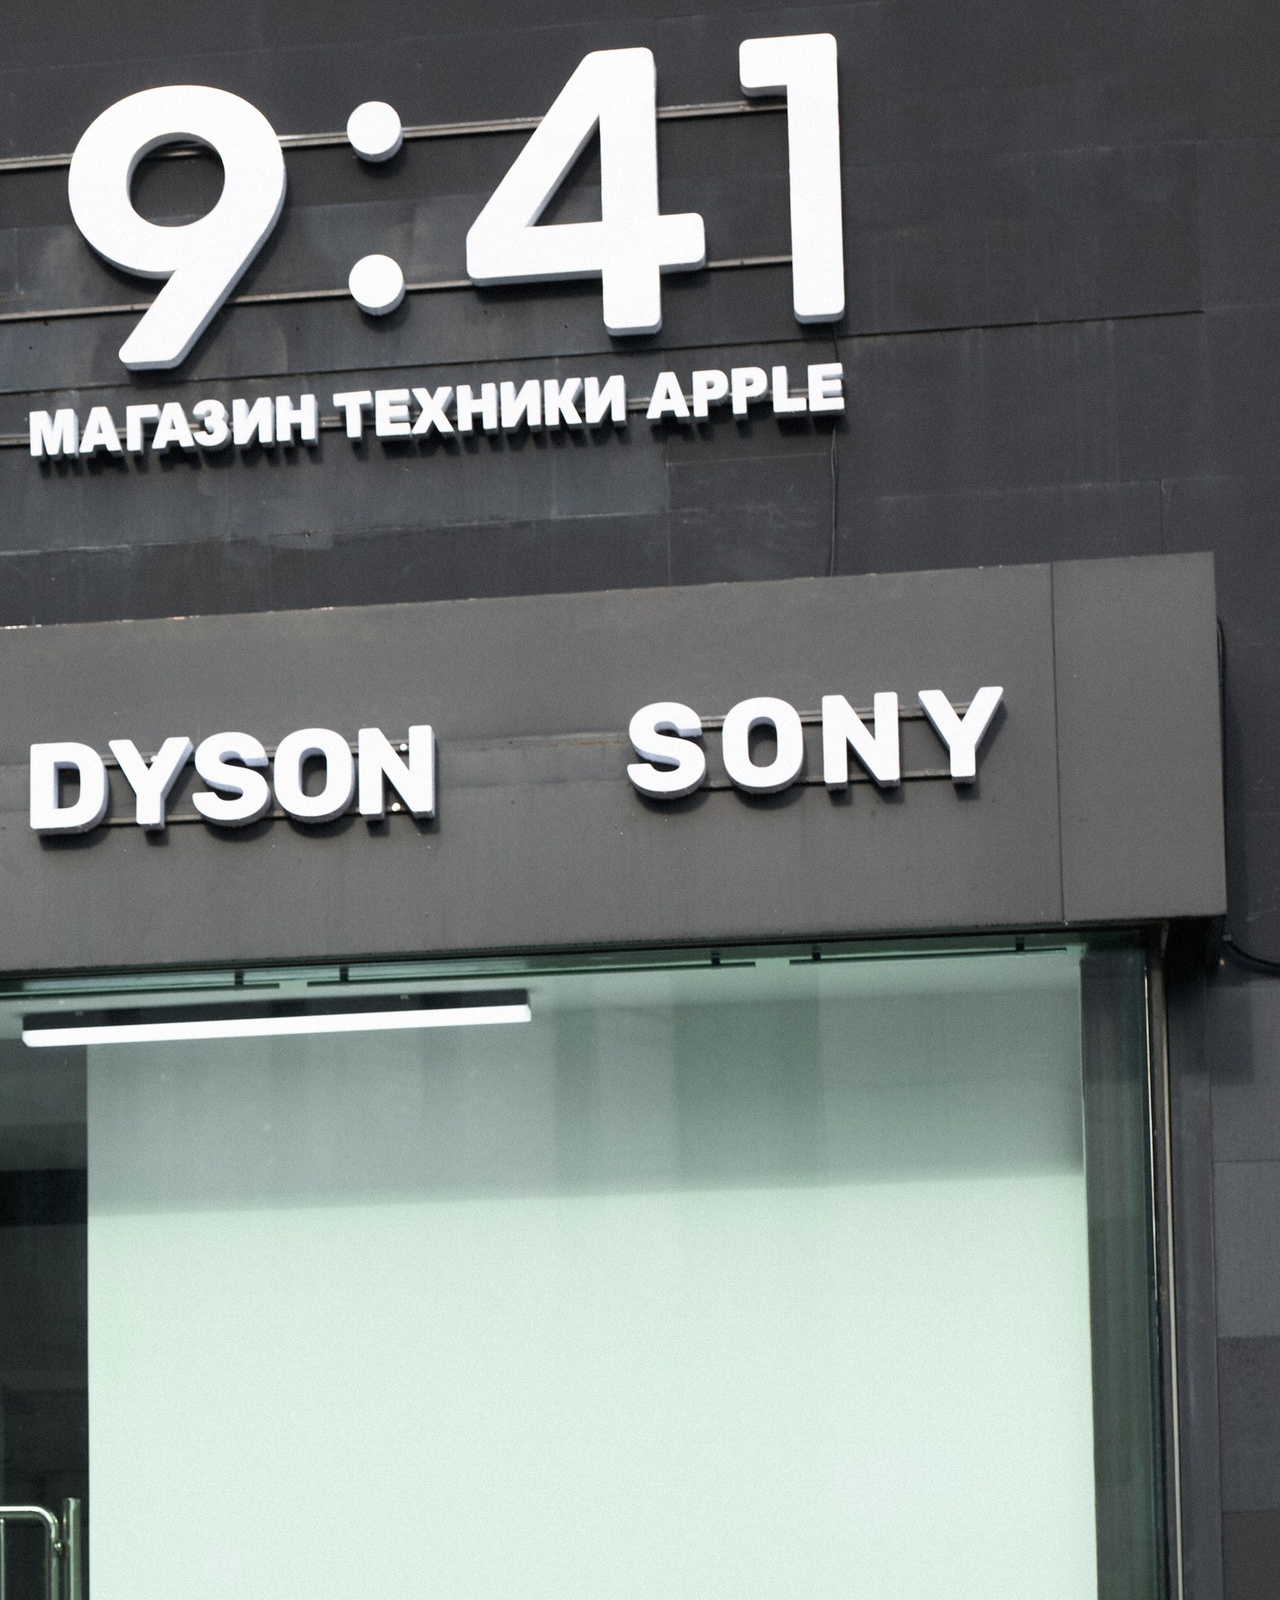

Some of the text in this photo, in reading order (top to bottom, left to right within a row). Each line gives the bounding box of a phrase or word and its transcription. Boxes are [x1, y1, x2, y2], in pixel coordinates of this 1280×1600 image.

[68, 32, 845, 371] 9:41
[29, 363, 845, 457] МАГАЗИН ТЕХНИКИ APPLE
[29, 725, 436, 835] DYSON
[626, 686, 1004, 799] SONY
